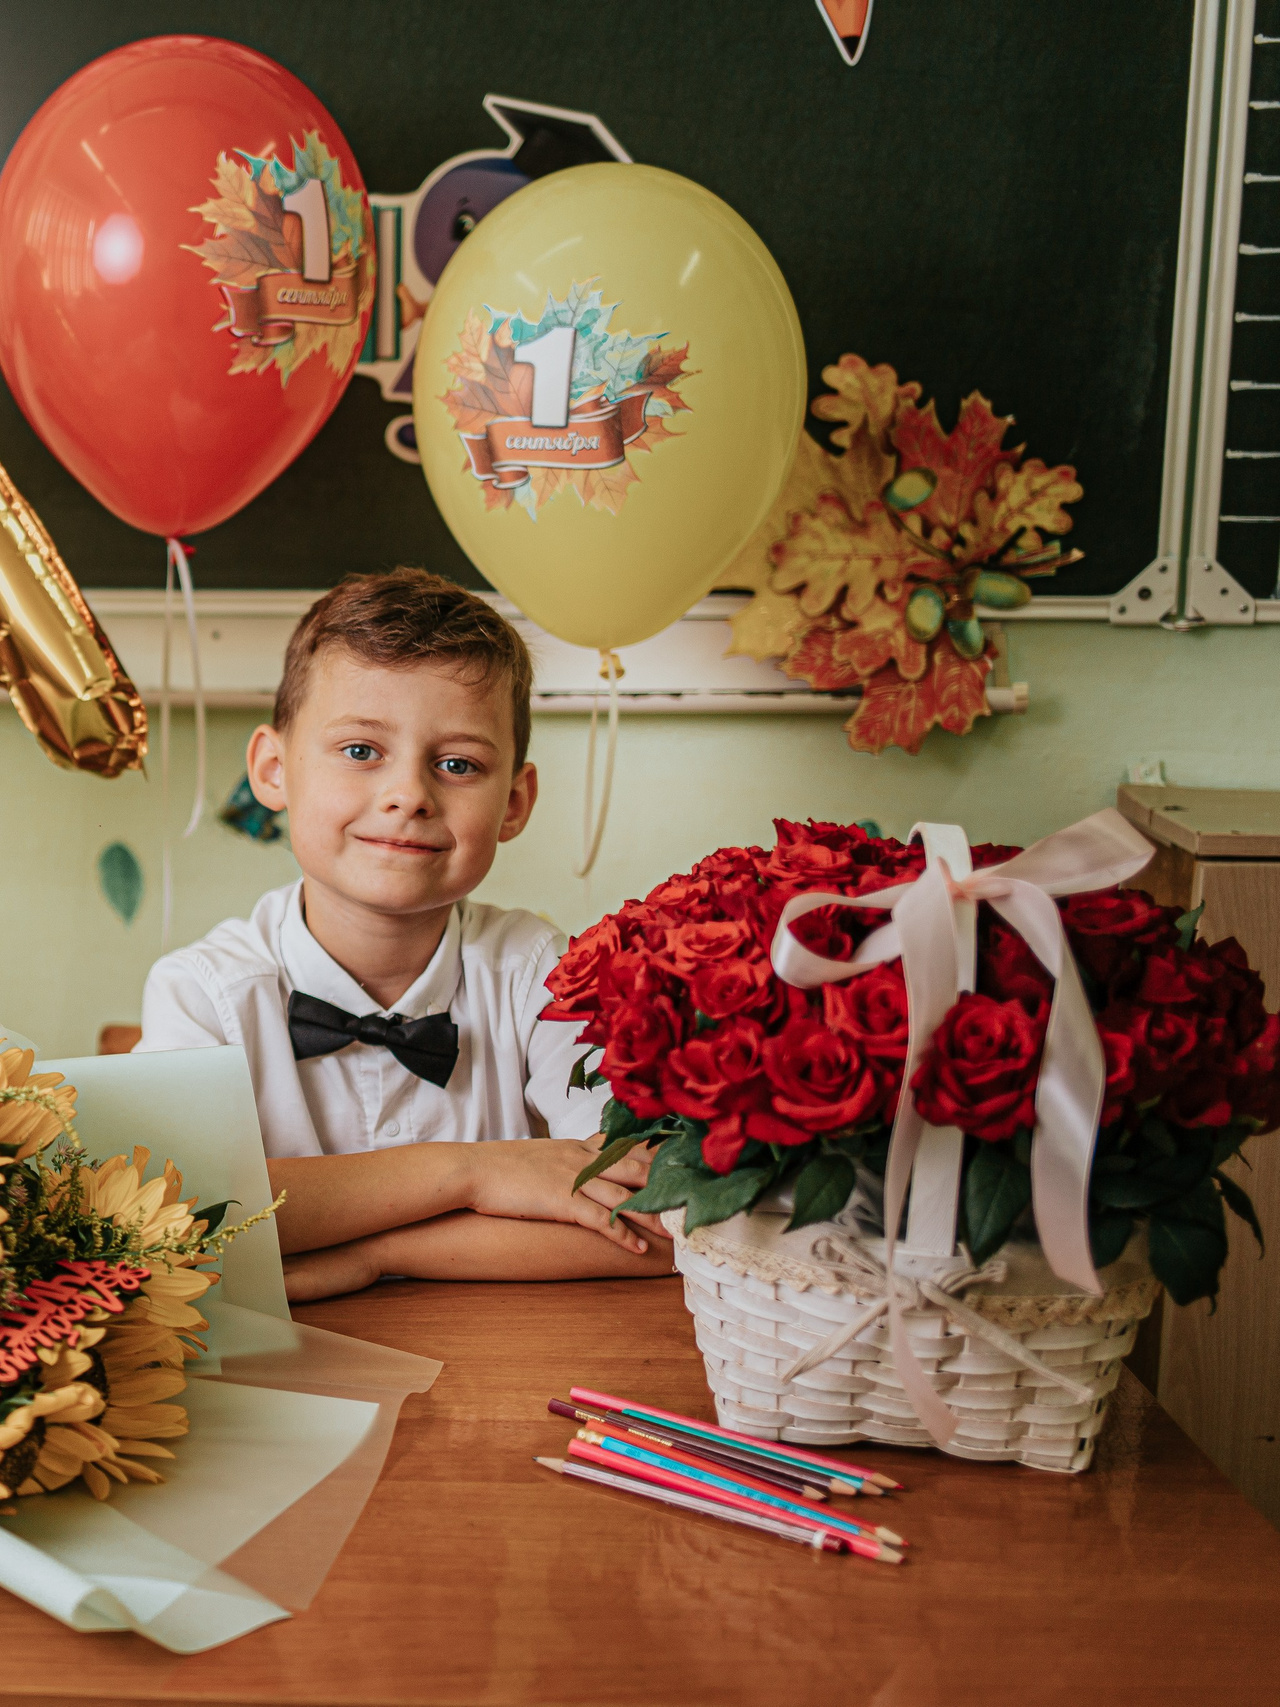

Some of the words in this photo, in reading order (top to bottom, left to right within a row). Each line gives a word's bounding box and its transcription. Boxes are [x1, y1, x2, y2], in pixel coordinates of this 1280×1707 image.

[283, 178, 331, 282] 1
[514, 326, 576, 428] 1
[505, 431, 600, 456] сентября
